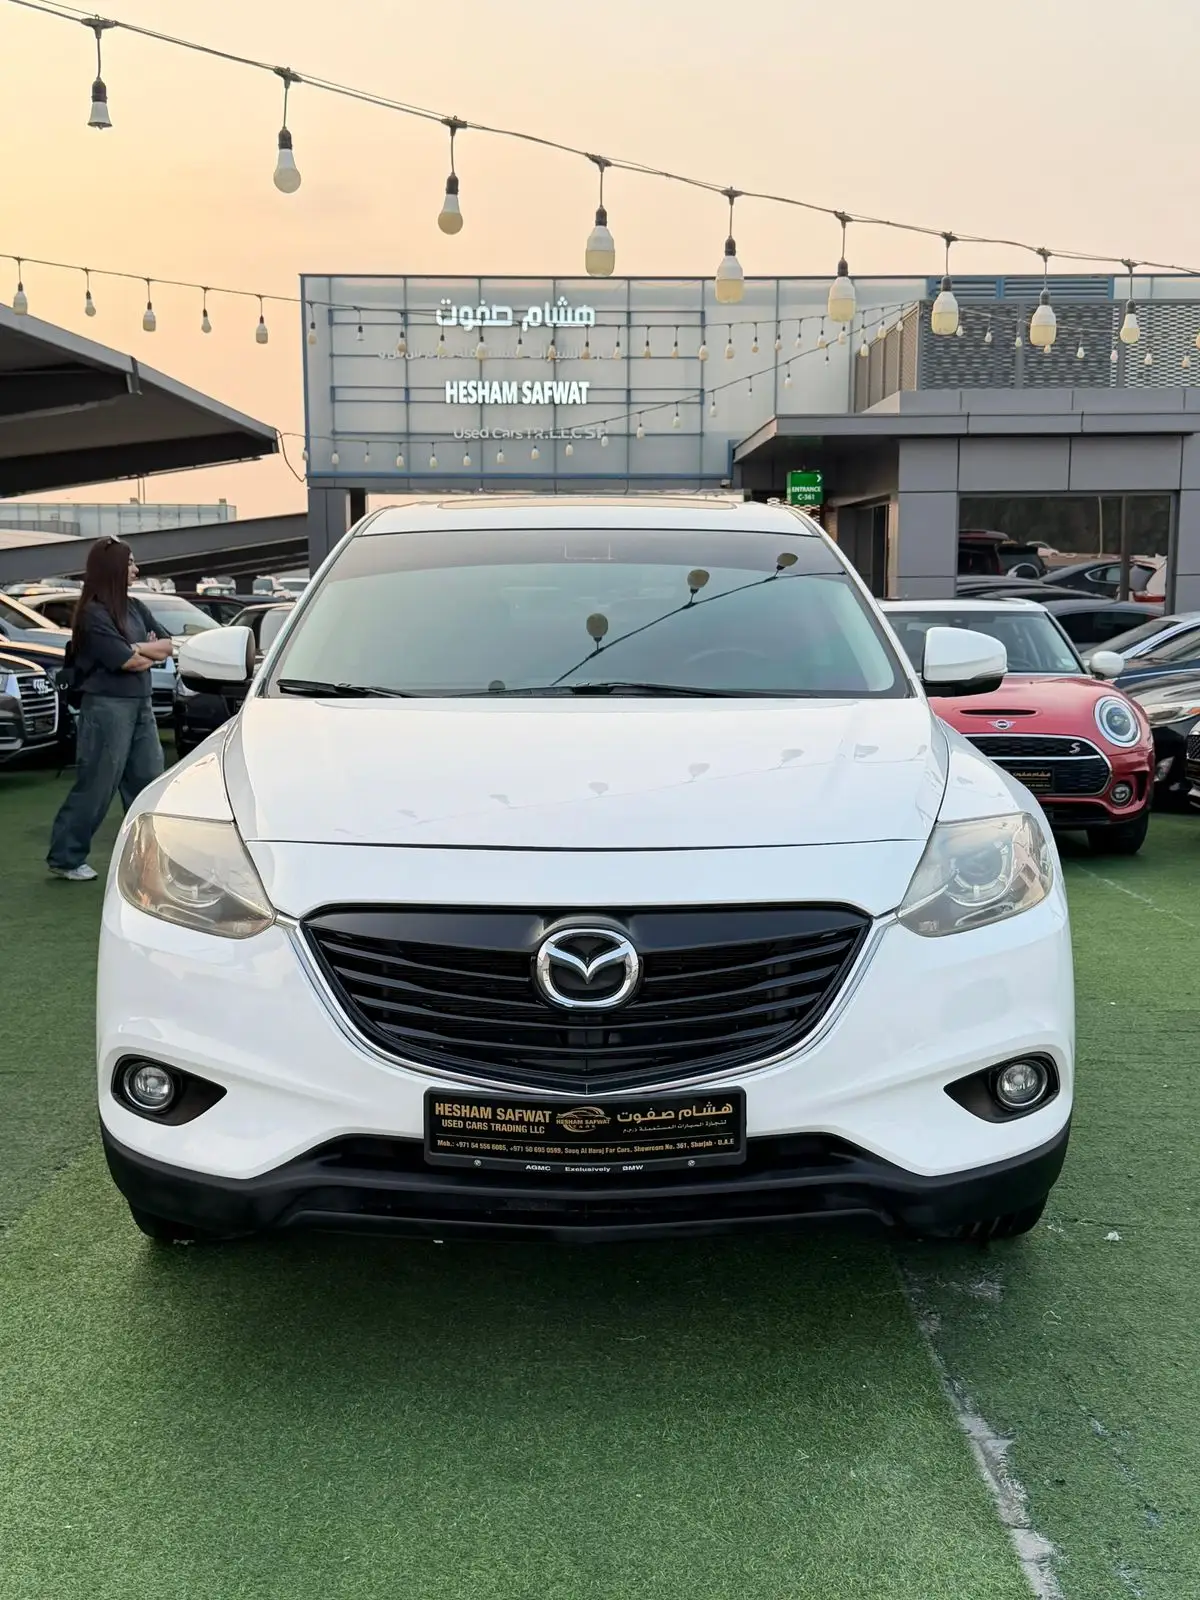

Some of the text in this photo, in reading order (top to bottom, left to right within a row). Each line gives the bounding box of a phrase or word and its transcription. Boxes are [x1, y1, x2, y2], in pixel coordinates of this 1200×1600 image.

[435, 296, 596, 332] هشام صفوت
[445, 380, 590, 405] HESHAM SAFWAT
[453, 426, 489, 439] Used
[492, 427, 523, 440] Cars
[1069, 742, 1080, 754] S
[435, 1102, 552, 1123] HESHAM SAFWAT
[617, 1101, 733, 1124] هشام صفوت
[441, 1119, 545, 1134] USED CARS TRADING LLC
